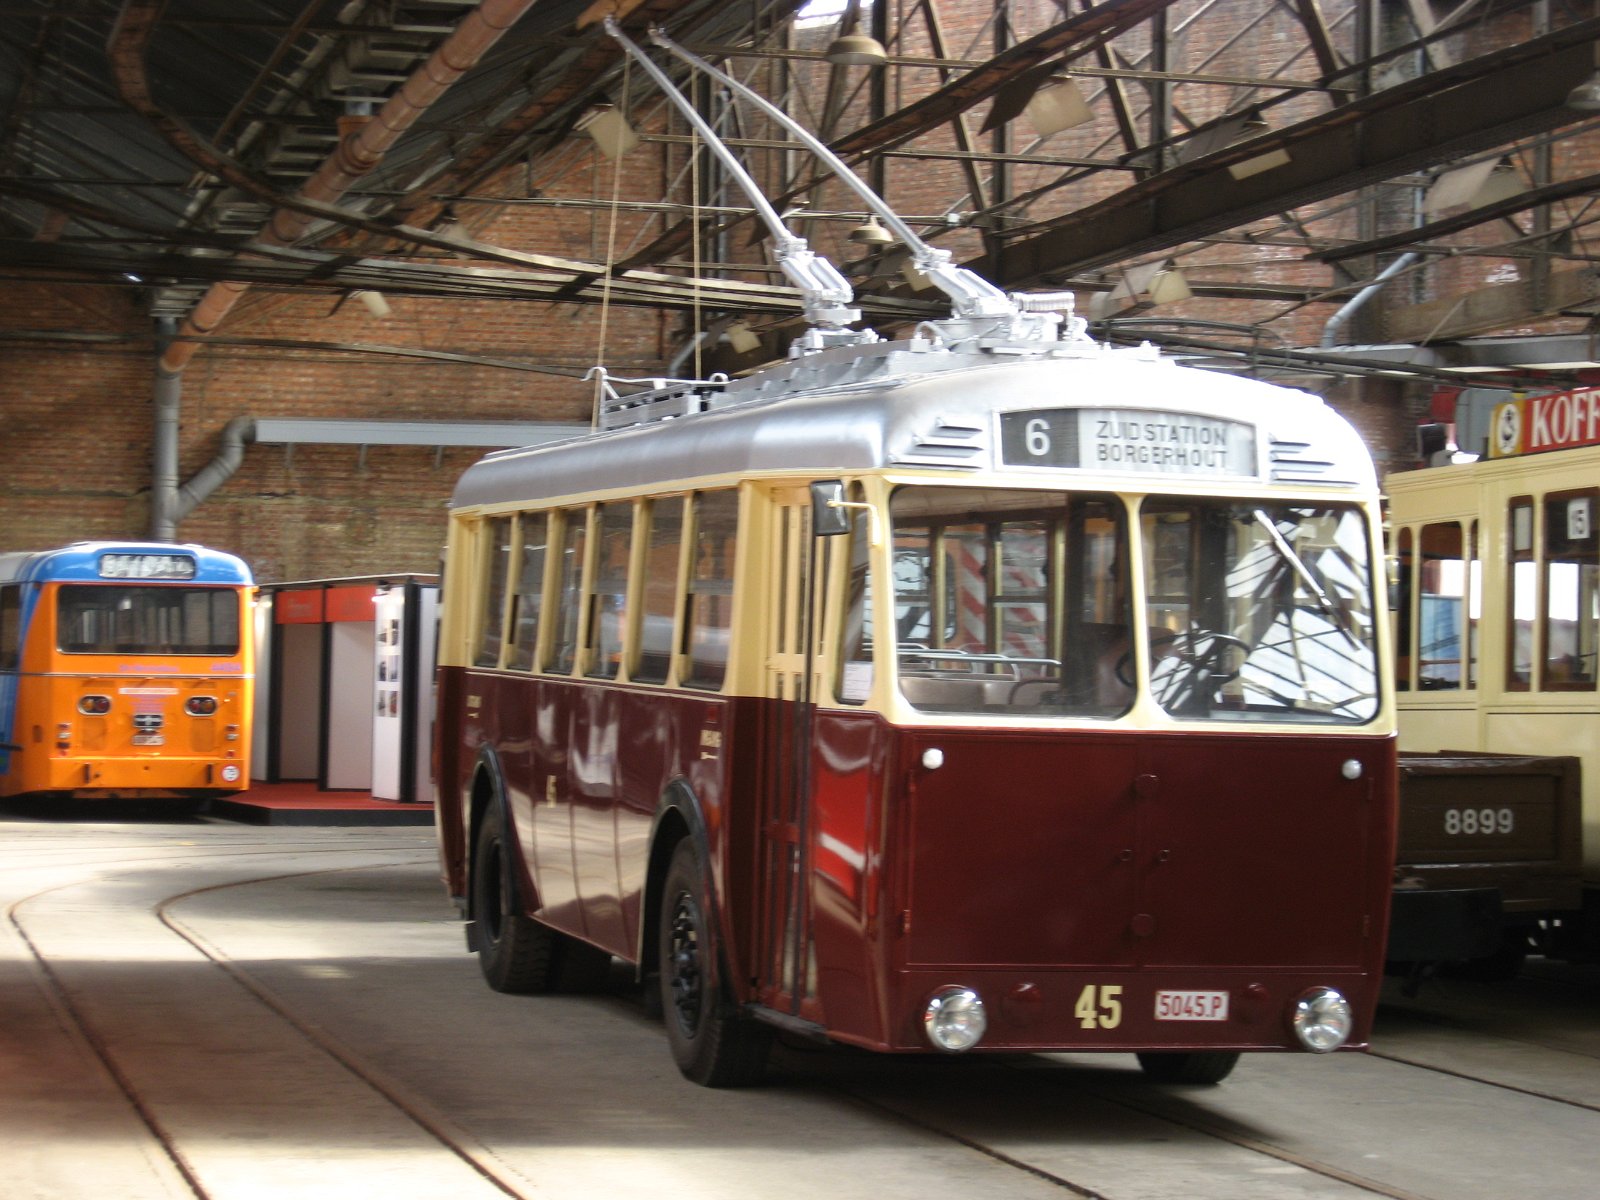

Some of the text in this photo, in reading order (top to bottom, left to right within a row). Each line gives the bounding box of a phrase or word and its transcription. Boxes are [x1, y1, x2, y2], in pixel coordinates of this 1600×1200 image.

[1095, 420, 1228, 446] ZUIDSTATION
[1531, 389, 1600, 448] KOFF
[1024, 418, 1050, 456] 6
[1096, 443, 1228, 468] BORGERHOUT
[1445, 808, 1513, 834] 8899
[1074, 985, 1123, 1029] 45
